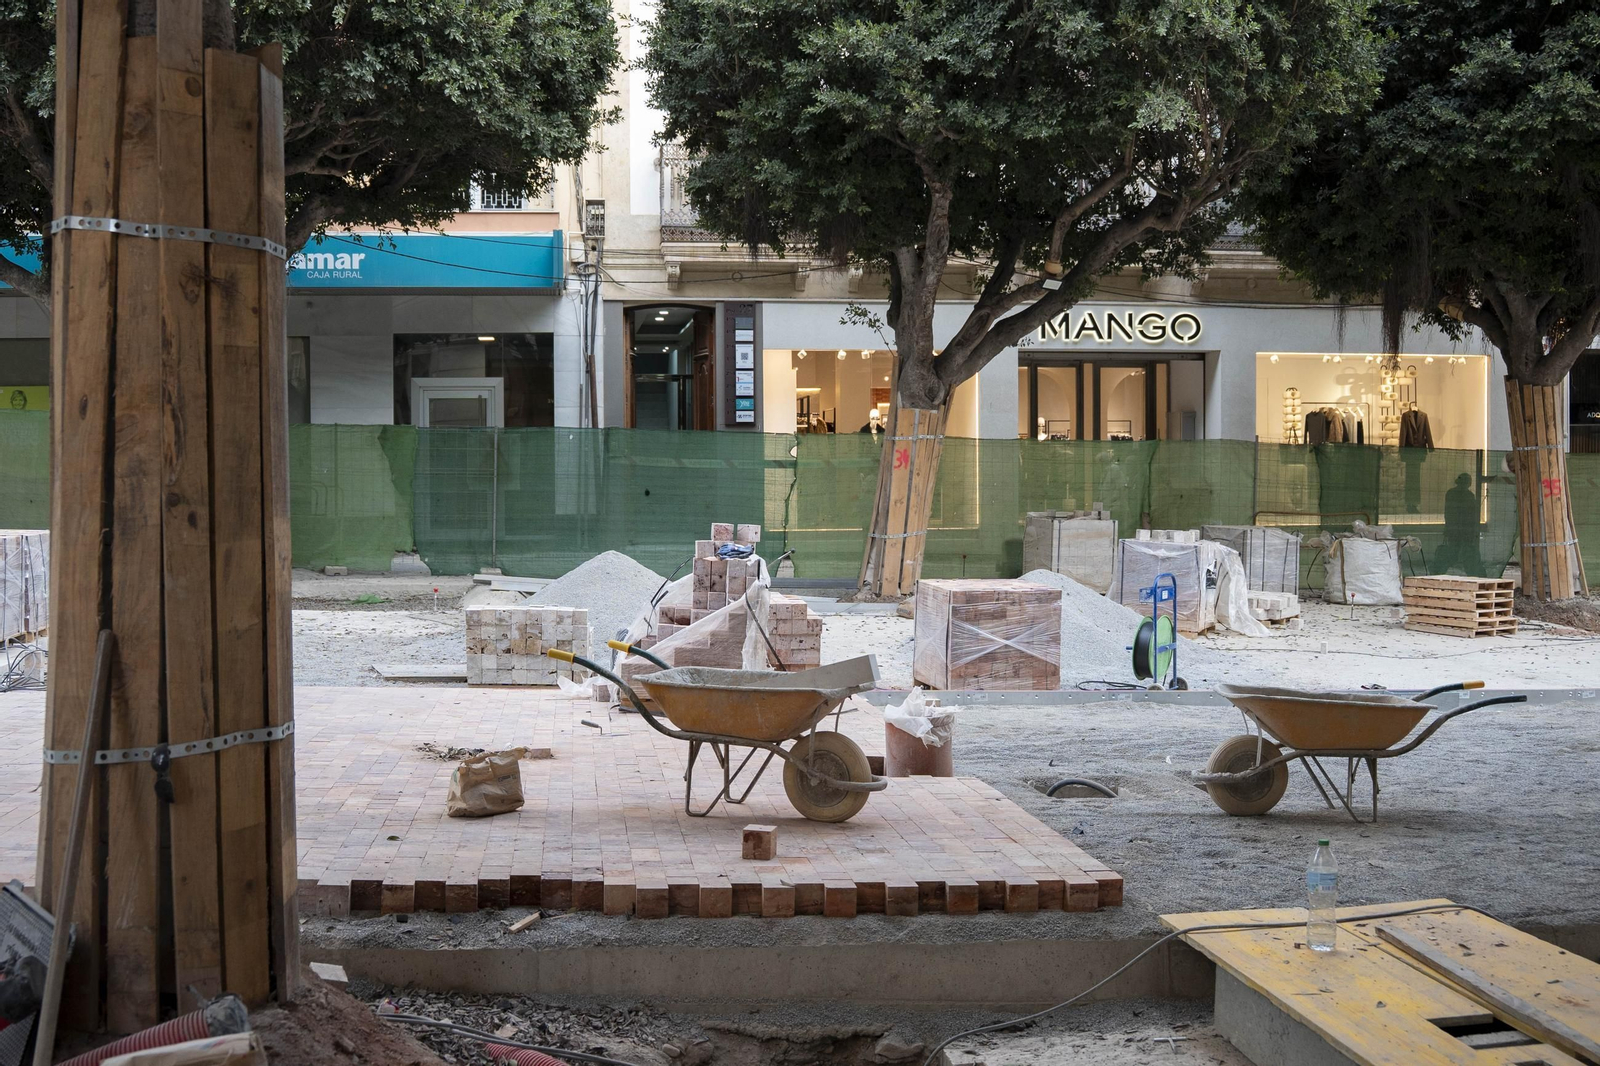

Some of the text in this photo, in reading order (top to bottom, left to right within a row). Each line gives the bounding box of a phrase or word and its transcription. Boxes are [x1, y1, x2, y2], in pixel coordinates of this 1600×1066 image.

[307, 270, 363, 279] CAJA RURAL
[1040, 312, 1202, 342] MANGO
